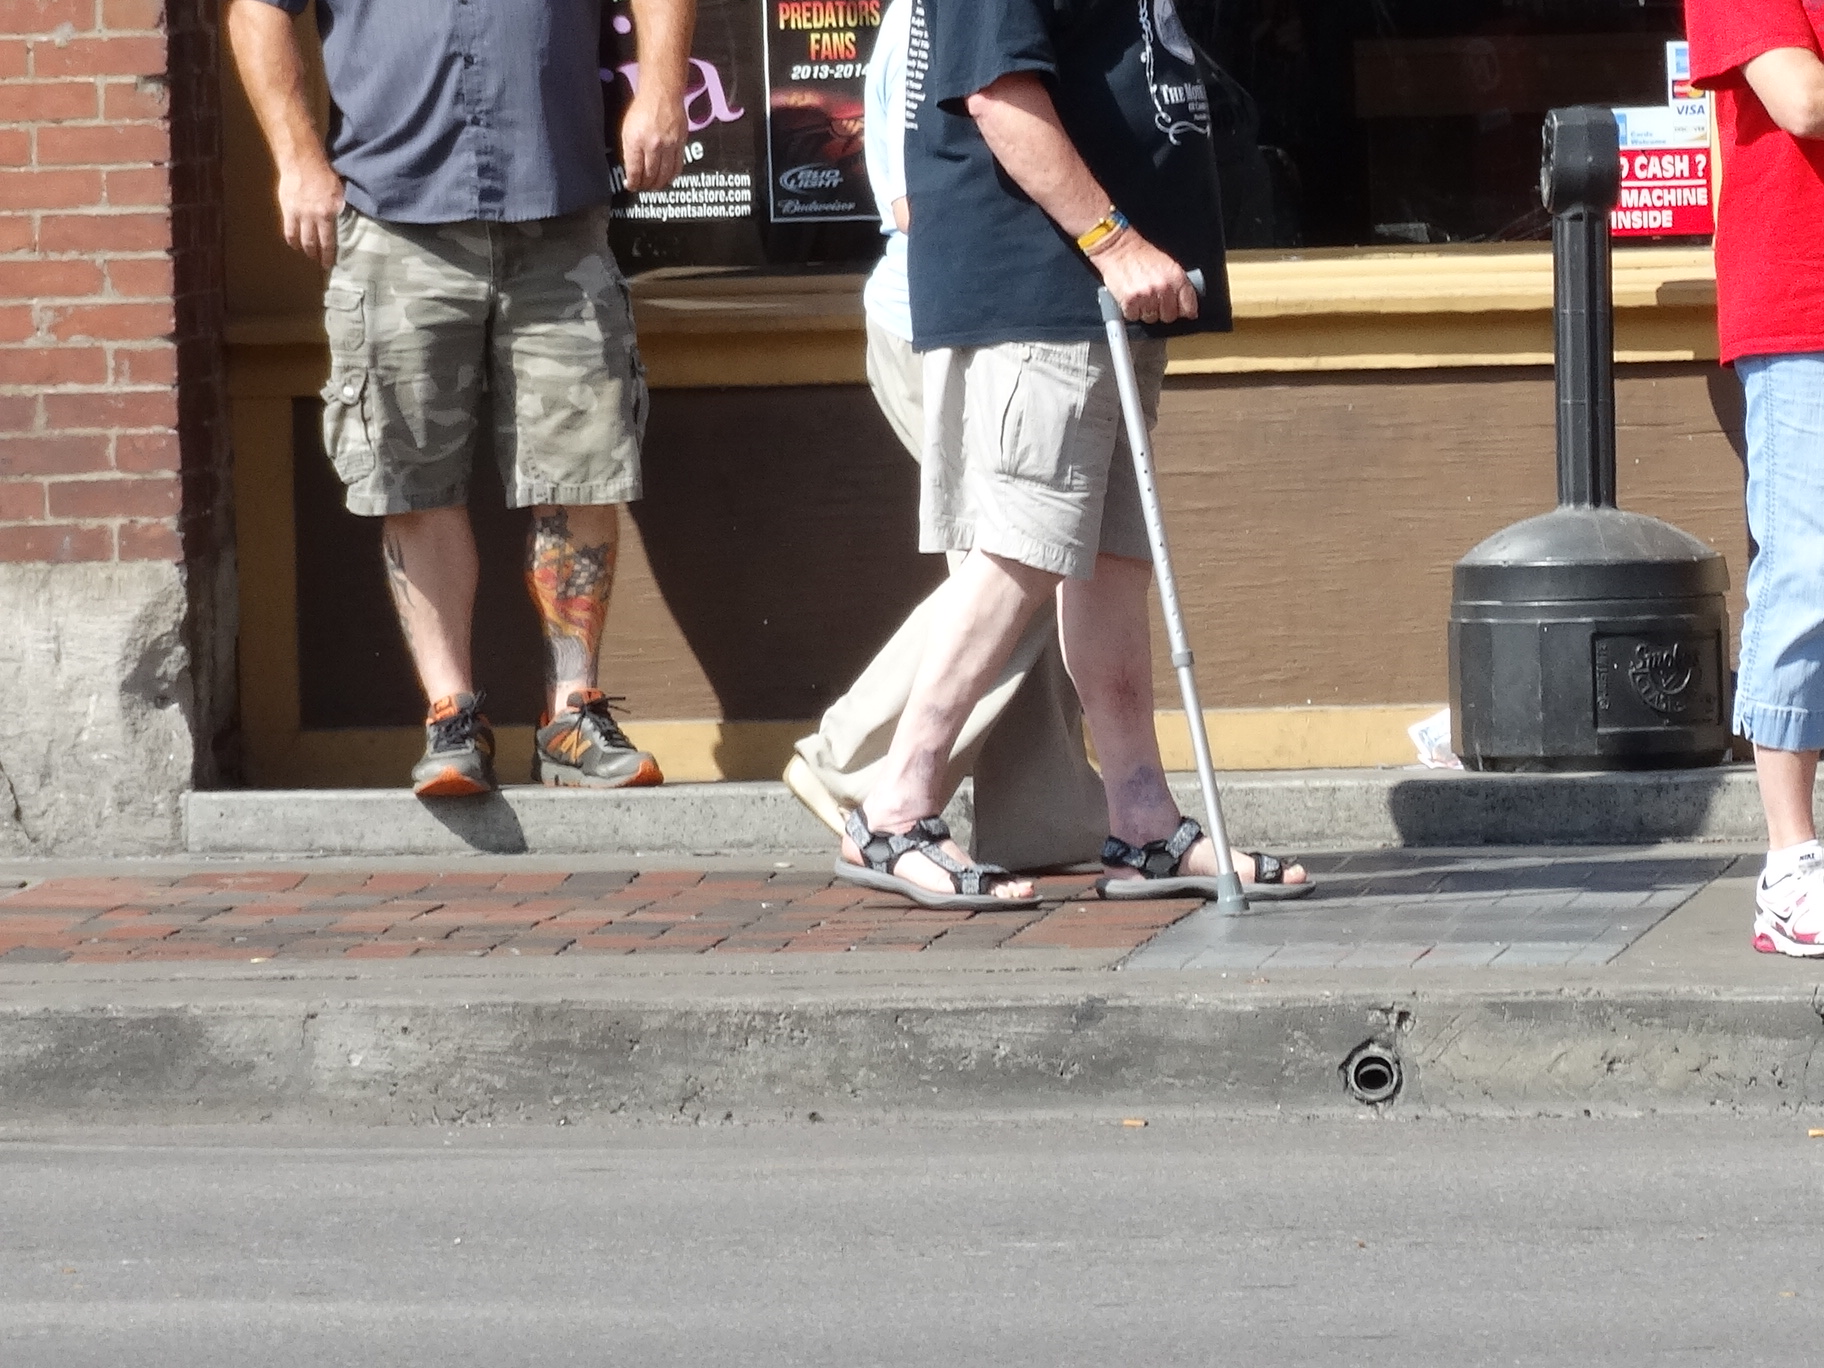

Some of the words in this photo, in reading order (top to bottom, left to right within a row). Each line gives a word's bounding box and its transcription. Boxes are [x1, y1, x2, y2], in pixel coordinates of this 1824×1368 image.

[810, 32, 857, 61] FANS
[791, 63, 869, 80] 2013-2014
[1677, 104, 1705, 116] VISA
[1634, 154, 1689, 179] CASH
[1695, 154, 1707, 178] ?
[639, 189, 752, 205] www.crockstore.com
[1621, 187, 1708, 208] MACHINE
[1611, 210, 1673, 230] INSIDE
